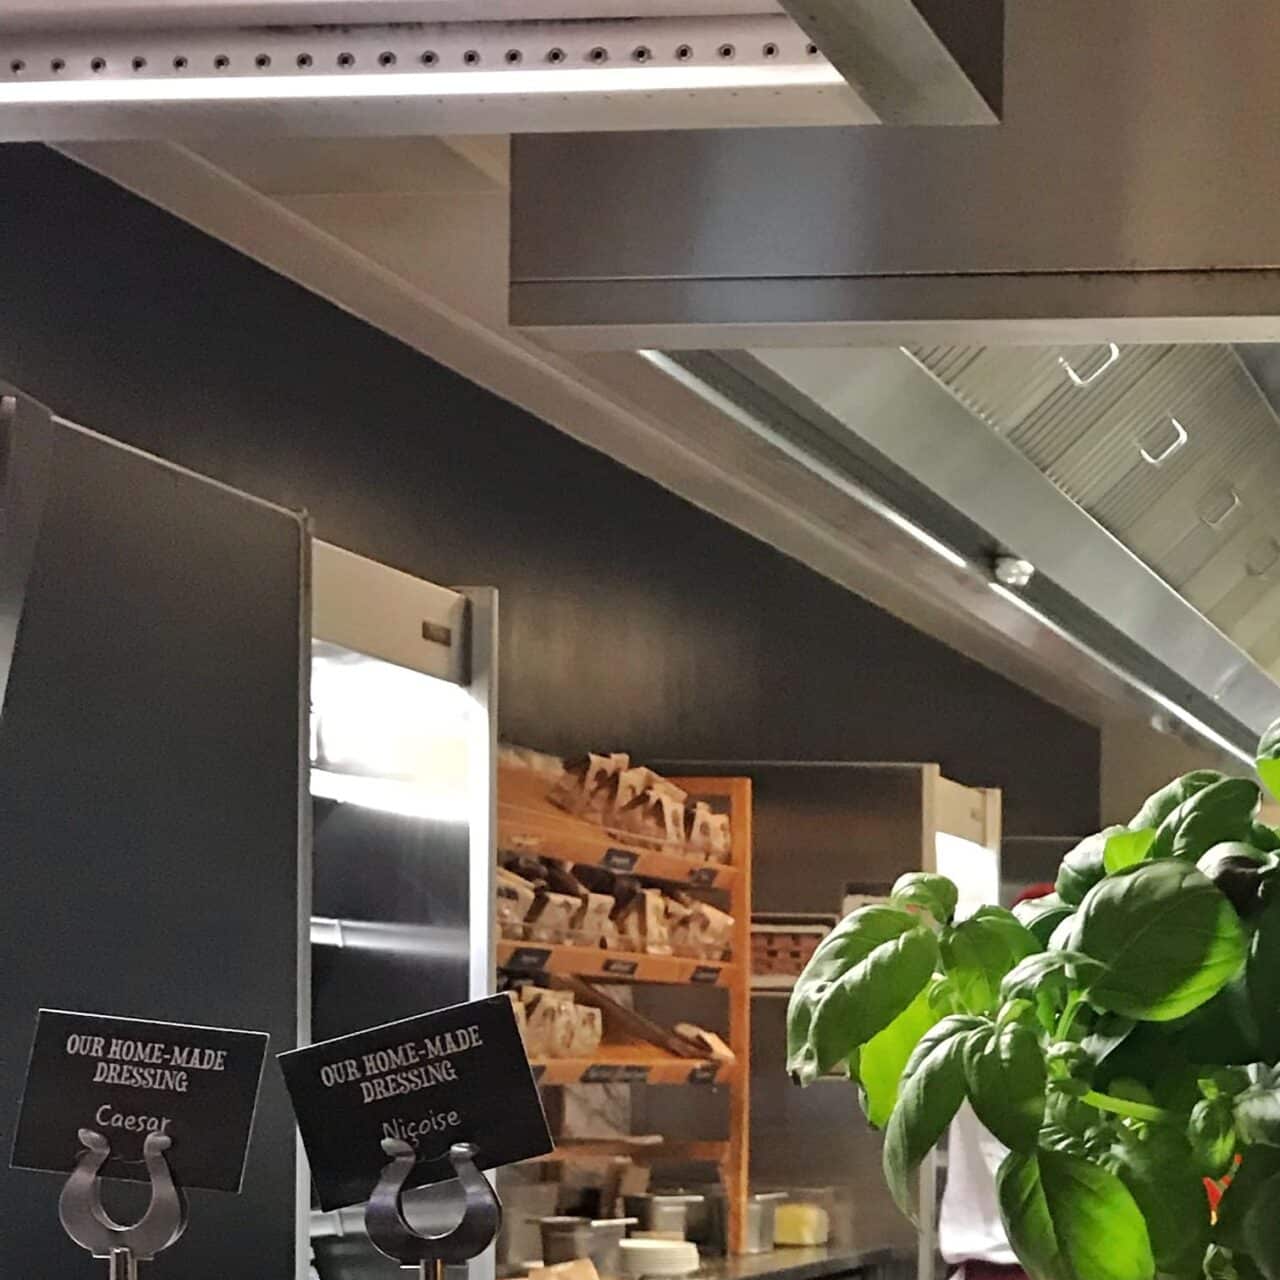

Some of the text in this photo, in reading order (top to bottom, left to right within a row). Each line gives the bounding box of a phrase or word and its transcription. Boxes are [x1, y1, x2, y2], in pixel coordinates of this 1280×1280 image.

[66, 1034, 227, 1071] OUR HOME-MADE
[320, 1025, 483, 1088] OUR HOME-MADE
[93, 1062, 189, 1092] DRESSING
[360, 1060, 457, 1103] DRESSING
[96, 1104, 172, 1133] Caesar
[382, 1109, 461, 1148] Niçoise
